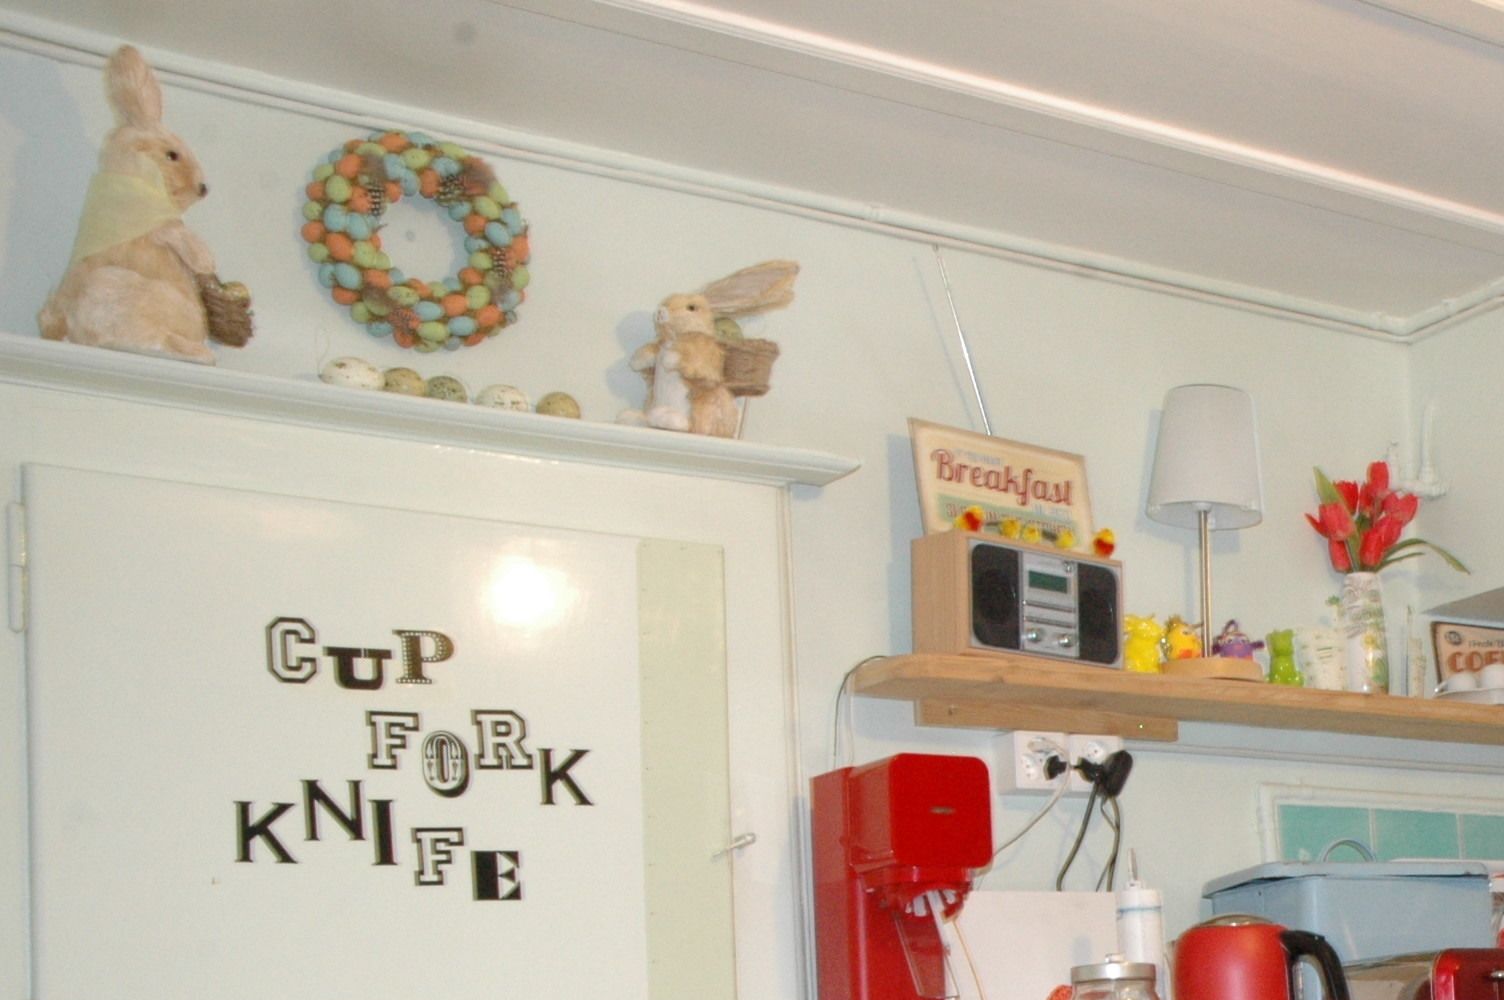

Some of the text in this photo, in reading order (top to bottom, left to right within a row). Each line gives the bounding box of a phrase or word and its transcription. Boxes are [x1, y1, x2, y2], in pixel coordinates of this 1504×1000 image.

[931, 448, 1074, 507] Breakfast
[265, 616, 455, 690] CUP
[365, 709, 596, 806] FORK
[233, 779, 523, 901] KNIFE
